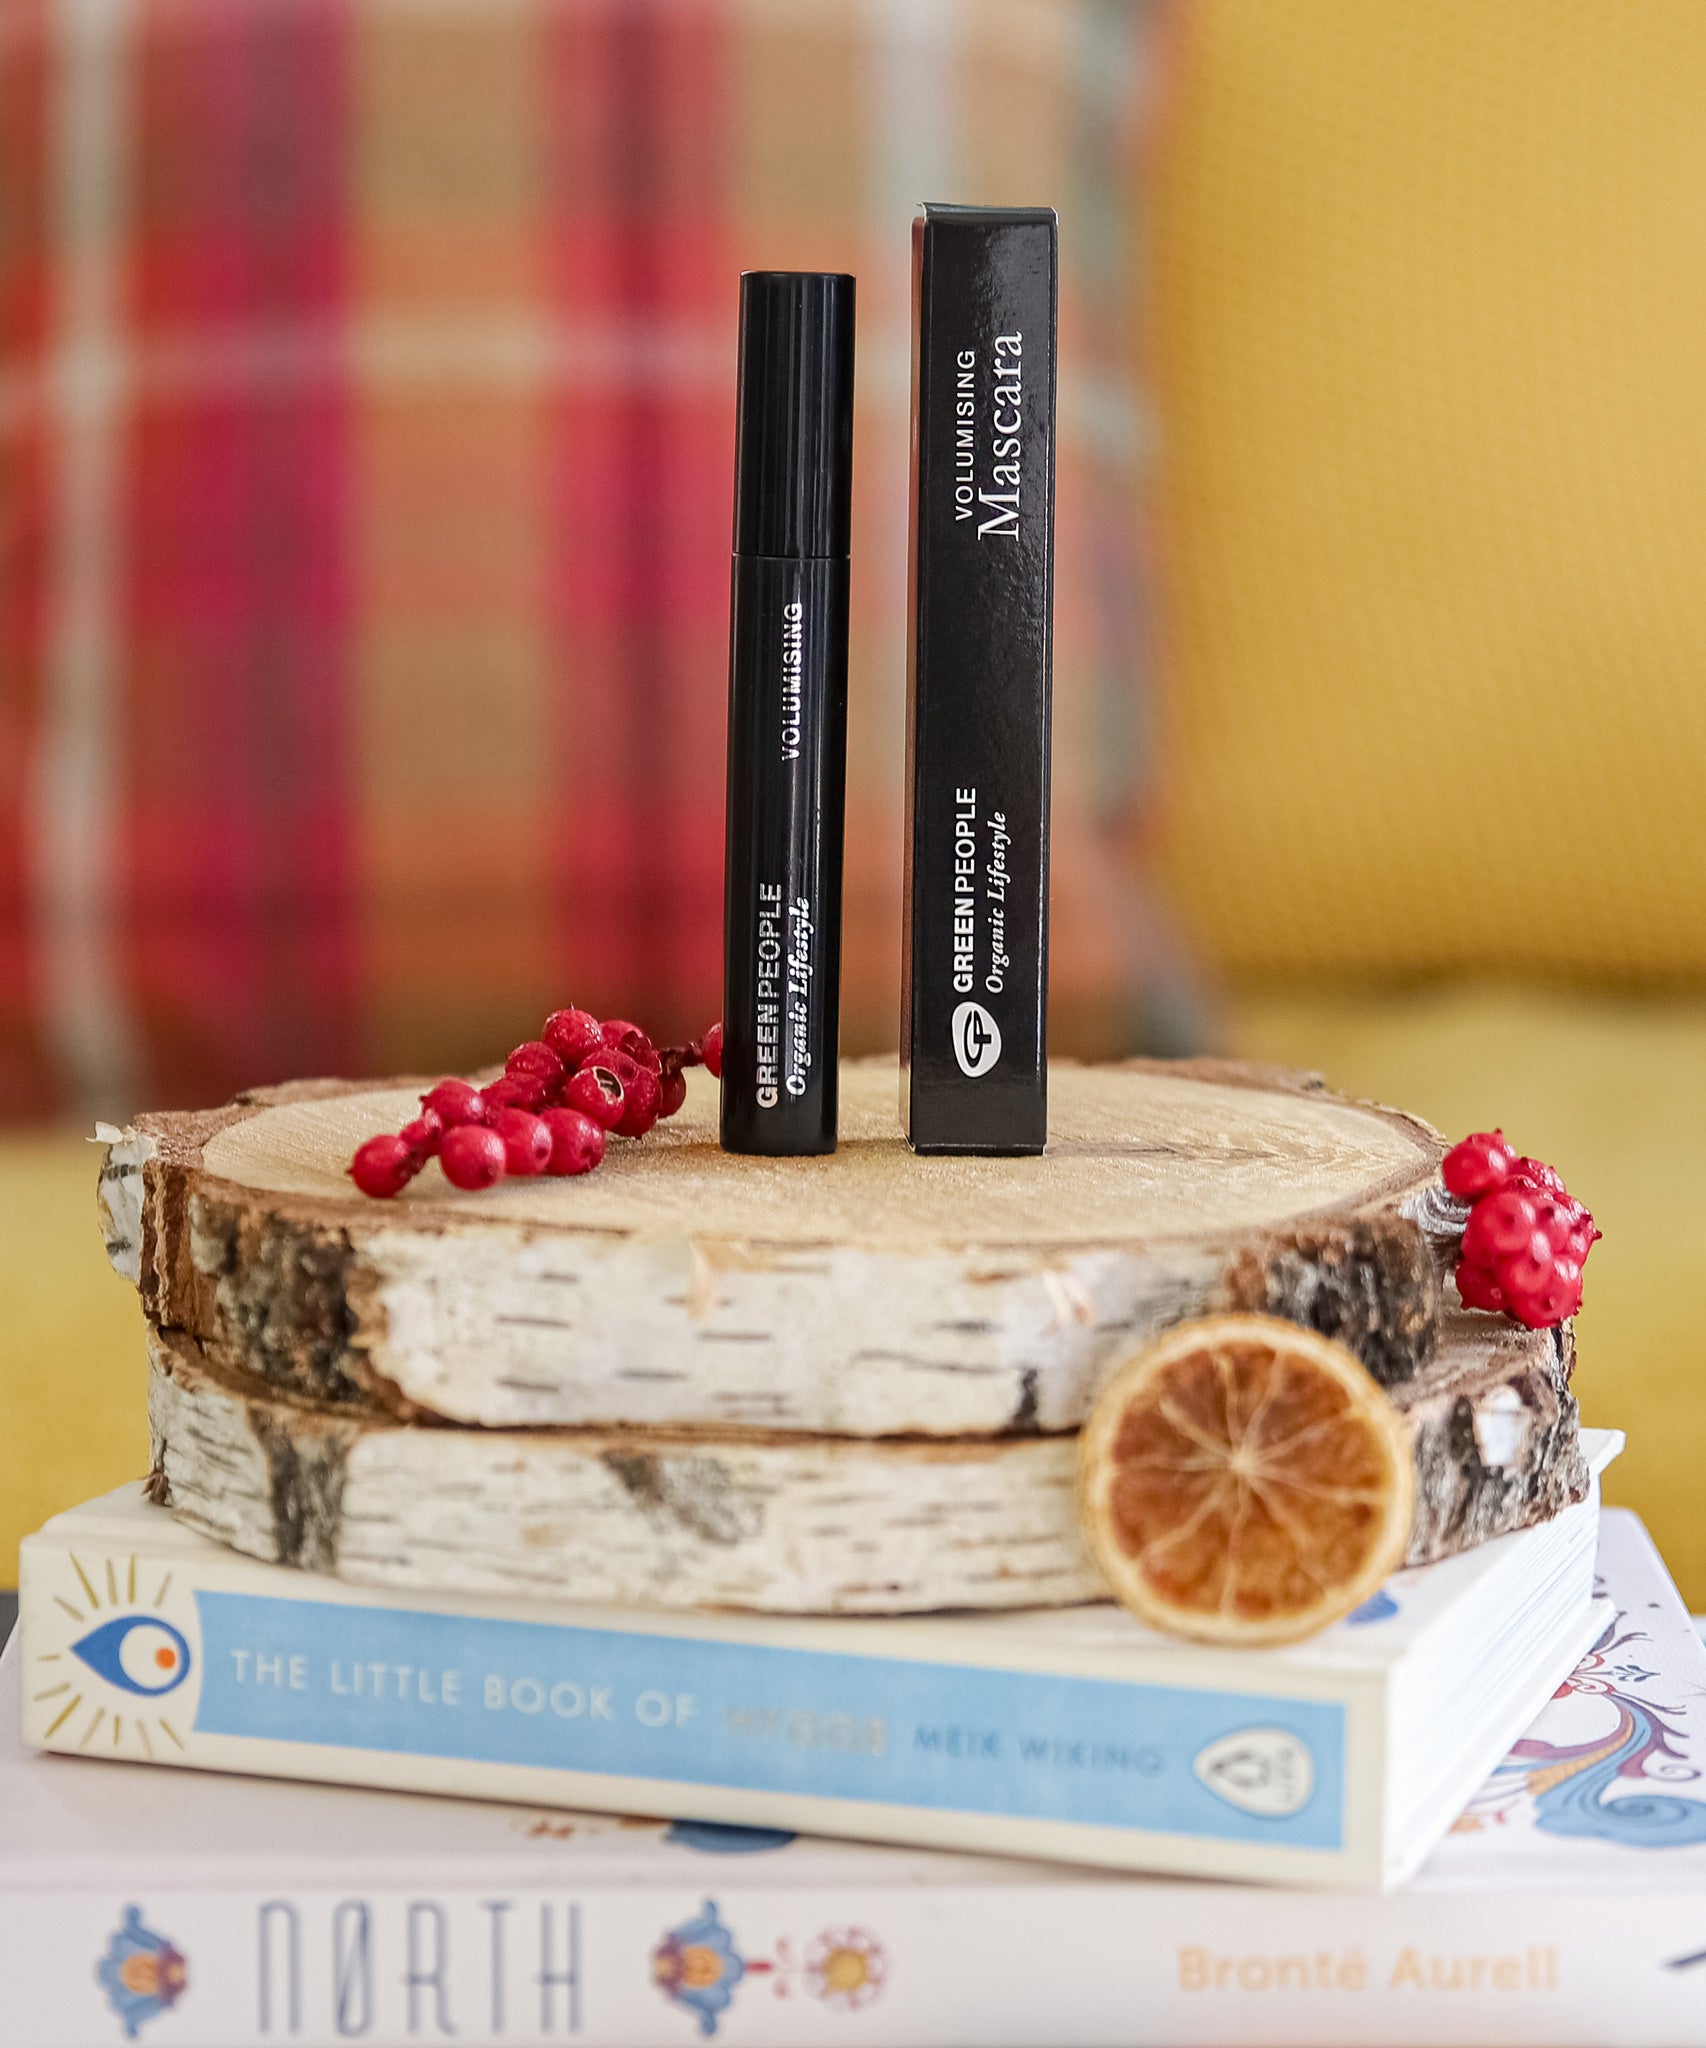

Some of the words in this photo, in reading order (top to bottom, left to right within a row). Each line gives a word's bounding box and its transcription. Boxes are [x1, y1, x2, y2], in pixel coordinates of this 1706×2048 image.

[955, 349, 976, 521] VOLUMISING
[977, 330, 1023, 541] Mascara
[781, 602, 803, 761] VOLUMISING
[956, 786, 977, 893] PEOPLE
[986, 810, 1012, 903] Lifestyle
[758, 882, 782, 998] PEOPLE
[787, 896, 816, 998] Lifestyle
[953, 898, 976, 994] GREEN
[984, 907, 1007, 994] Organic
[756, 1001, 780, 1108] GREEN
[785, 1001, 810, 1096] Organic
[230, 1649, 308, 1691] THE
[330, 1659, 462, 1706] LITTLE
[483, 1674, 615, 1720] BOOK
[634, 1689, 698, 1728] OF
[724, 1705, 889, 1758] HYGGE
[912, 1725, 999, 1759] MEIK
[1017, 1735, 1164, 1778] WIKING
[257, 1899, 583, 2037] NØRTH
[1389, 1943, 1561, 1992] Aurell
